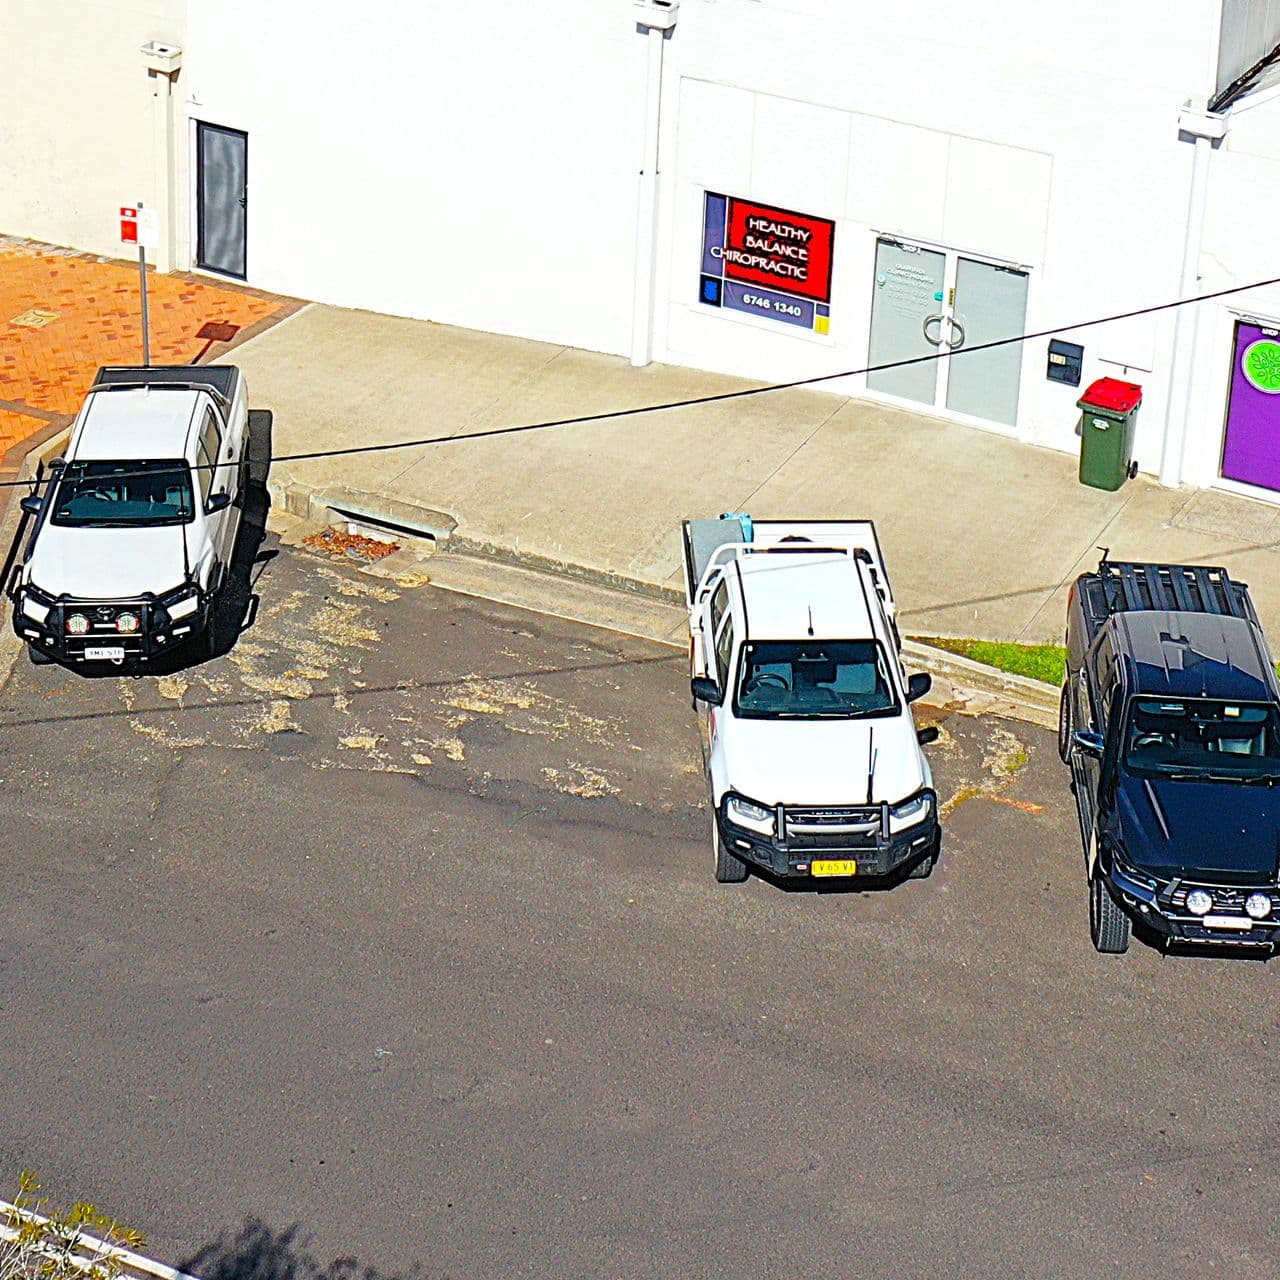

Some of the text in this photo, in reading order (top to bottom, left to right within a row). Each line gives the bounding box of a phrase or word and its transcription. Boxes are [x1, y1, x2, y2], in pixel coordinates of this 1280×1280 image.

[749, 218, 810, 241] HEALTHY
[745, 235, 808, 261] BALANCE
[710, 246, 807, 280] CHIROPRACTIC
[743, 294, 802, 316] 6746 1340
